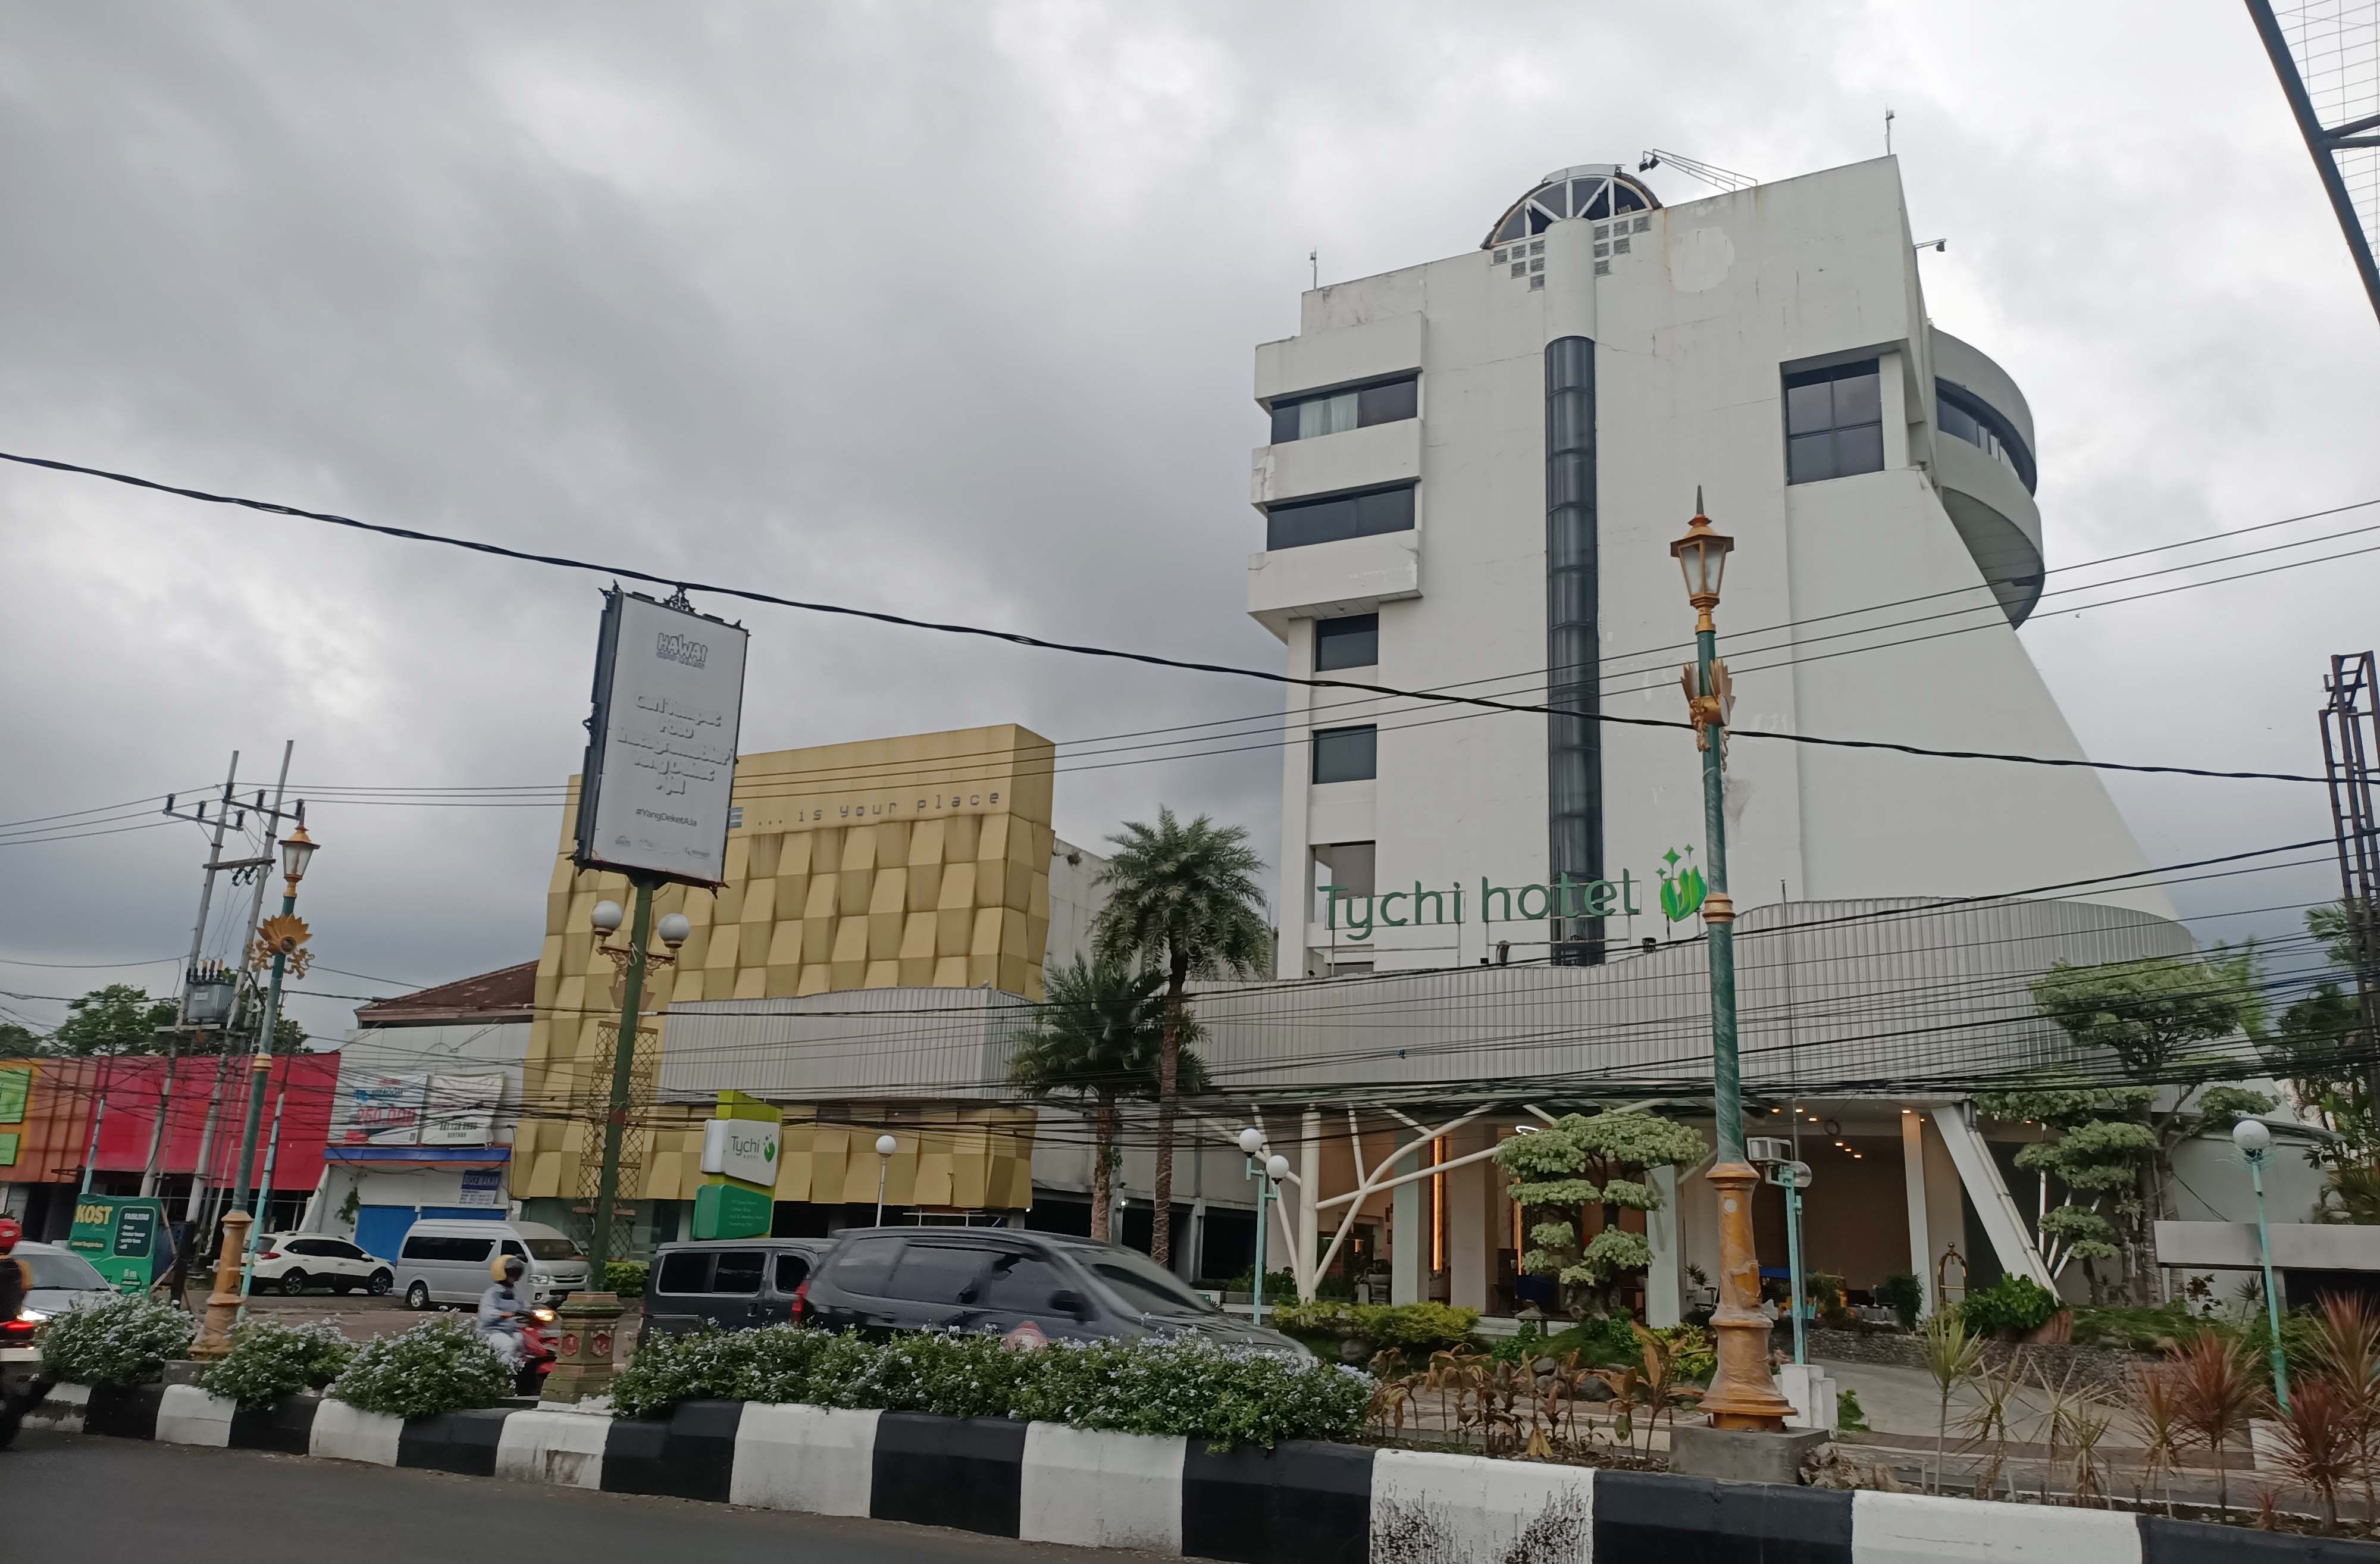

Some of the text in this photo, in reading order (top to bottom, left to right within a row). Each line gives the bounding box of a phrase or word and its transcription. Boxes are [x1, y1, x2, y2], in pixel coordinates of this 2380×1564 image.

[656, 632, 709, 662] HAWAI
[798, 807, 823, 822] is
[840, 800, 897, 818] your
[916, 791, 1000, 813] place
[1316, 867, 1640, 941] Tychi hotel
[731, 1136, 760, 1156] Tychi
[76, 1205, 113, 1224] KOST
